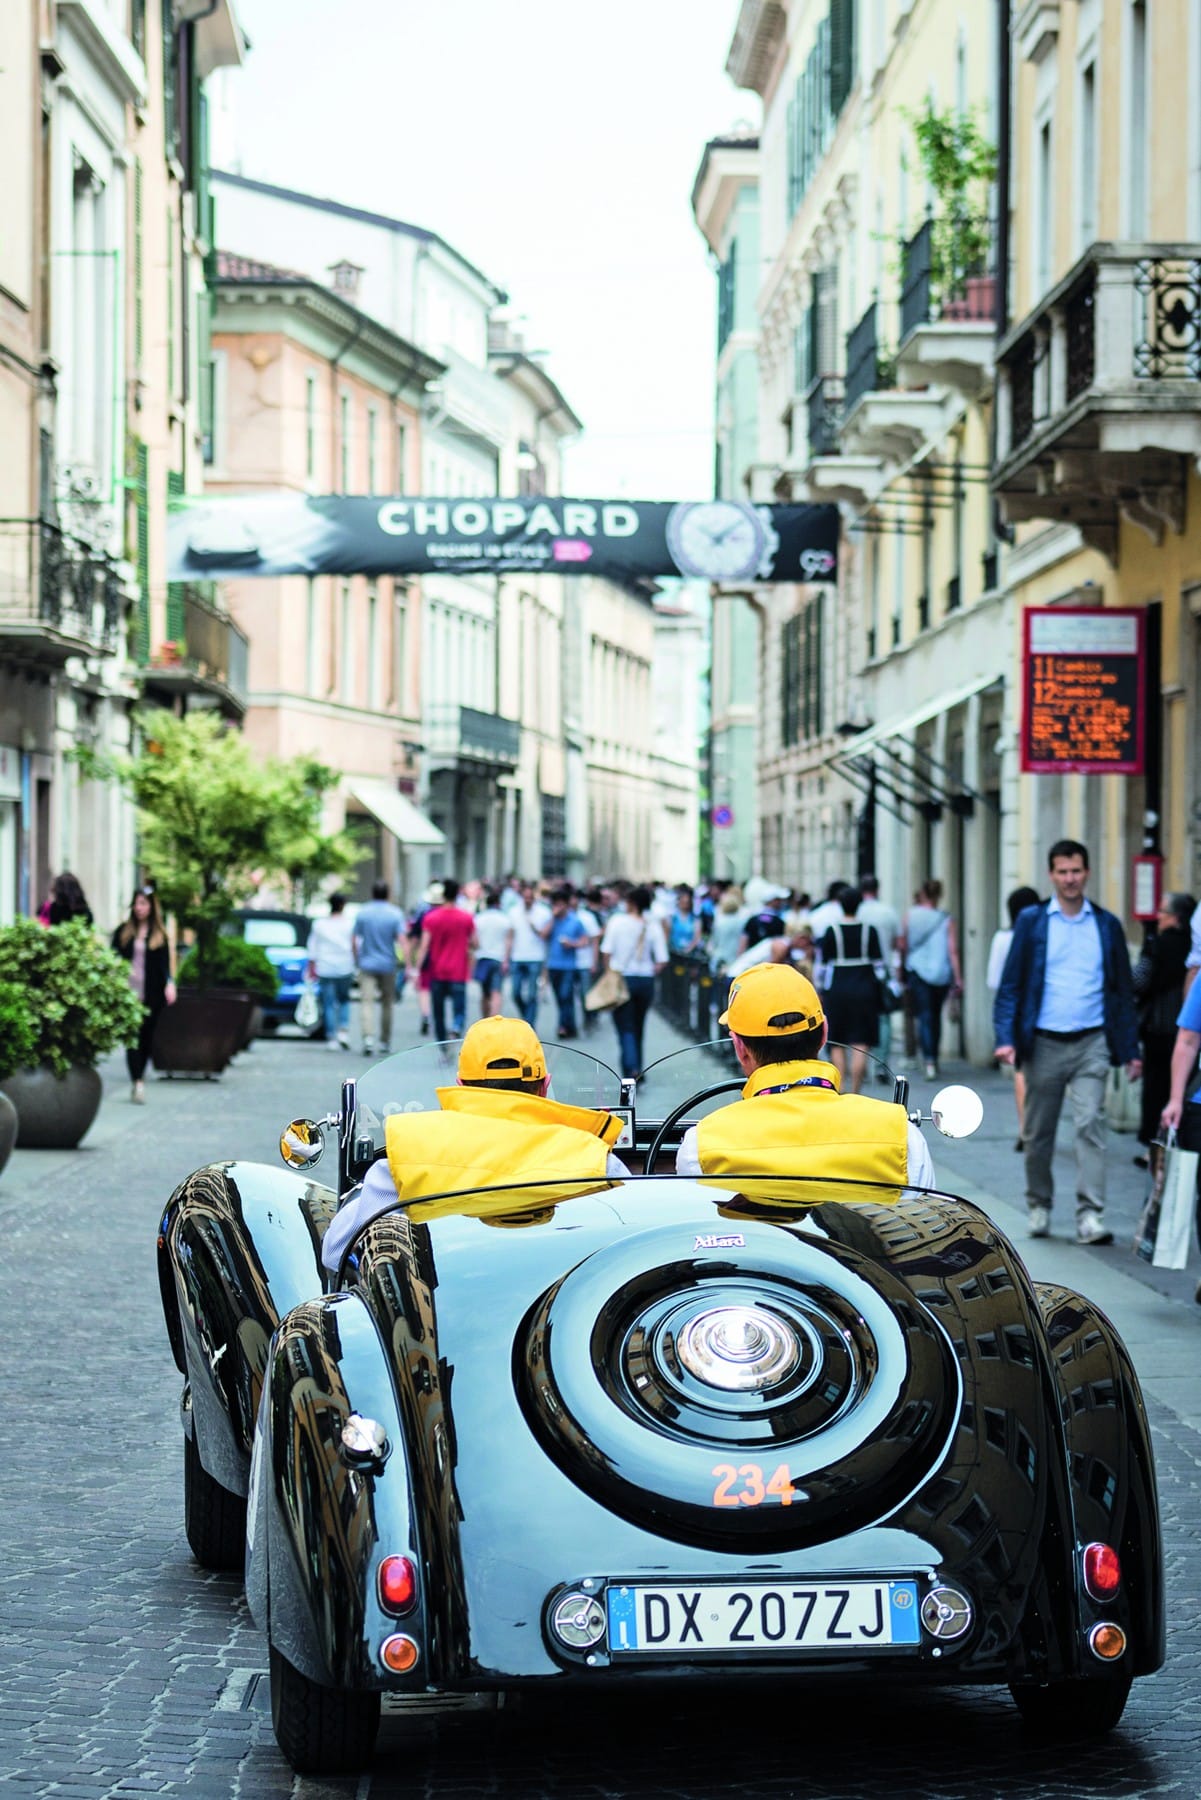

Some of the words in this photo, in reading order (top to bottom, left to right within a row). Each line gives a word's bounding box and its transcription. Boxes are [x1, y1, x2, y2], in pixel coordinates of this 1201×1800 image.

[377, 502, 639, 537] CHOPARD
[1034, 656, 1054, 679] 11
[1033, 681, 1056, 704] 12
[711, 1463, 796, 1506] 234
[644, 1593, 702, 1643] DX
[728, 1589, 885, 1641] 207ZJ
